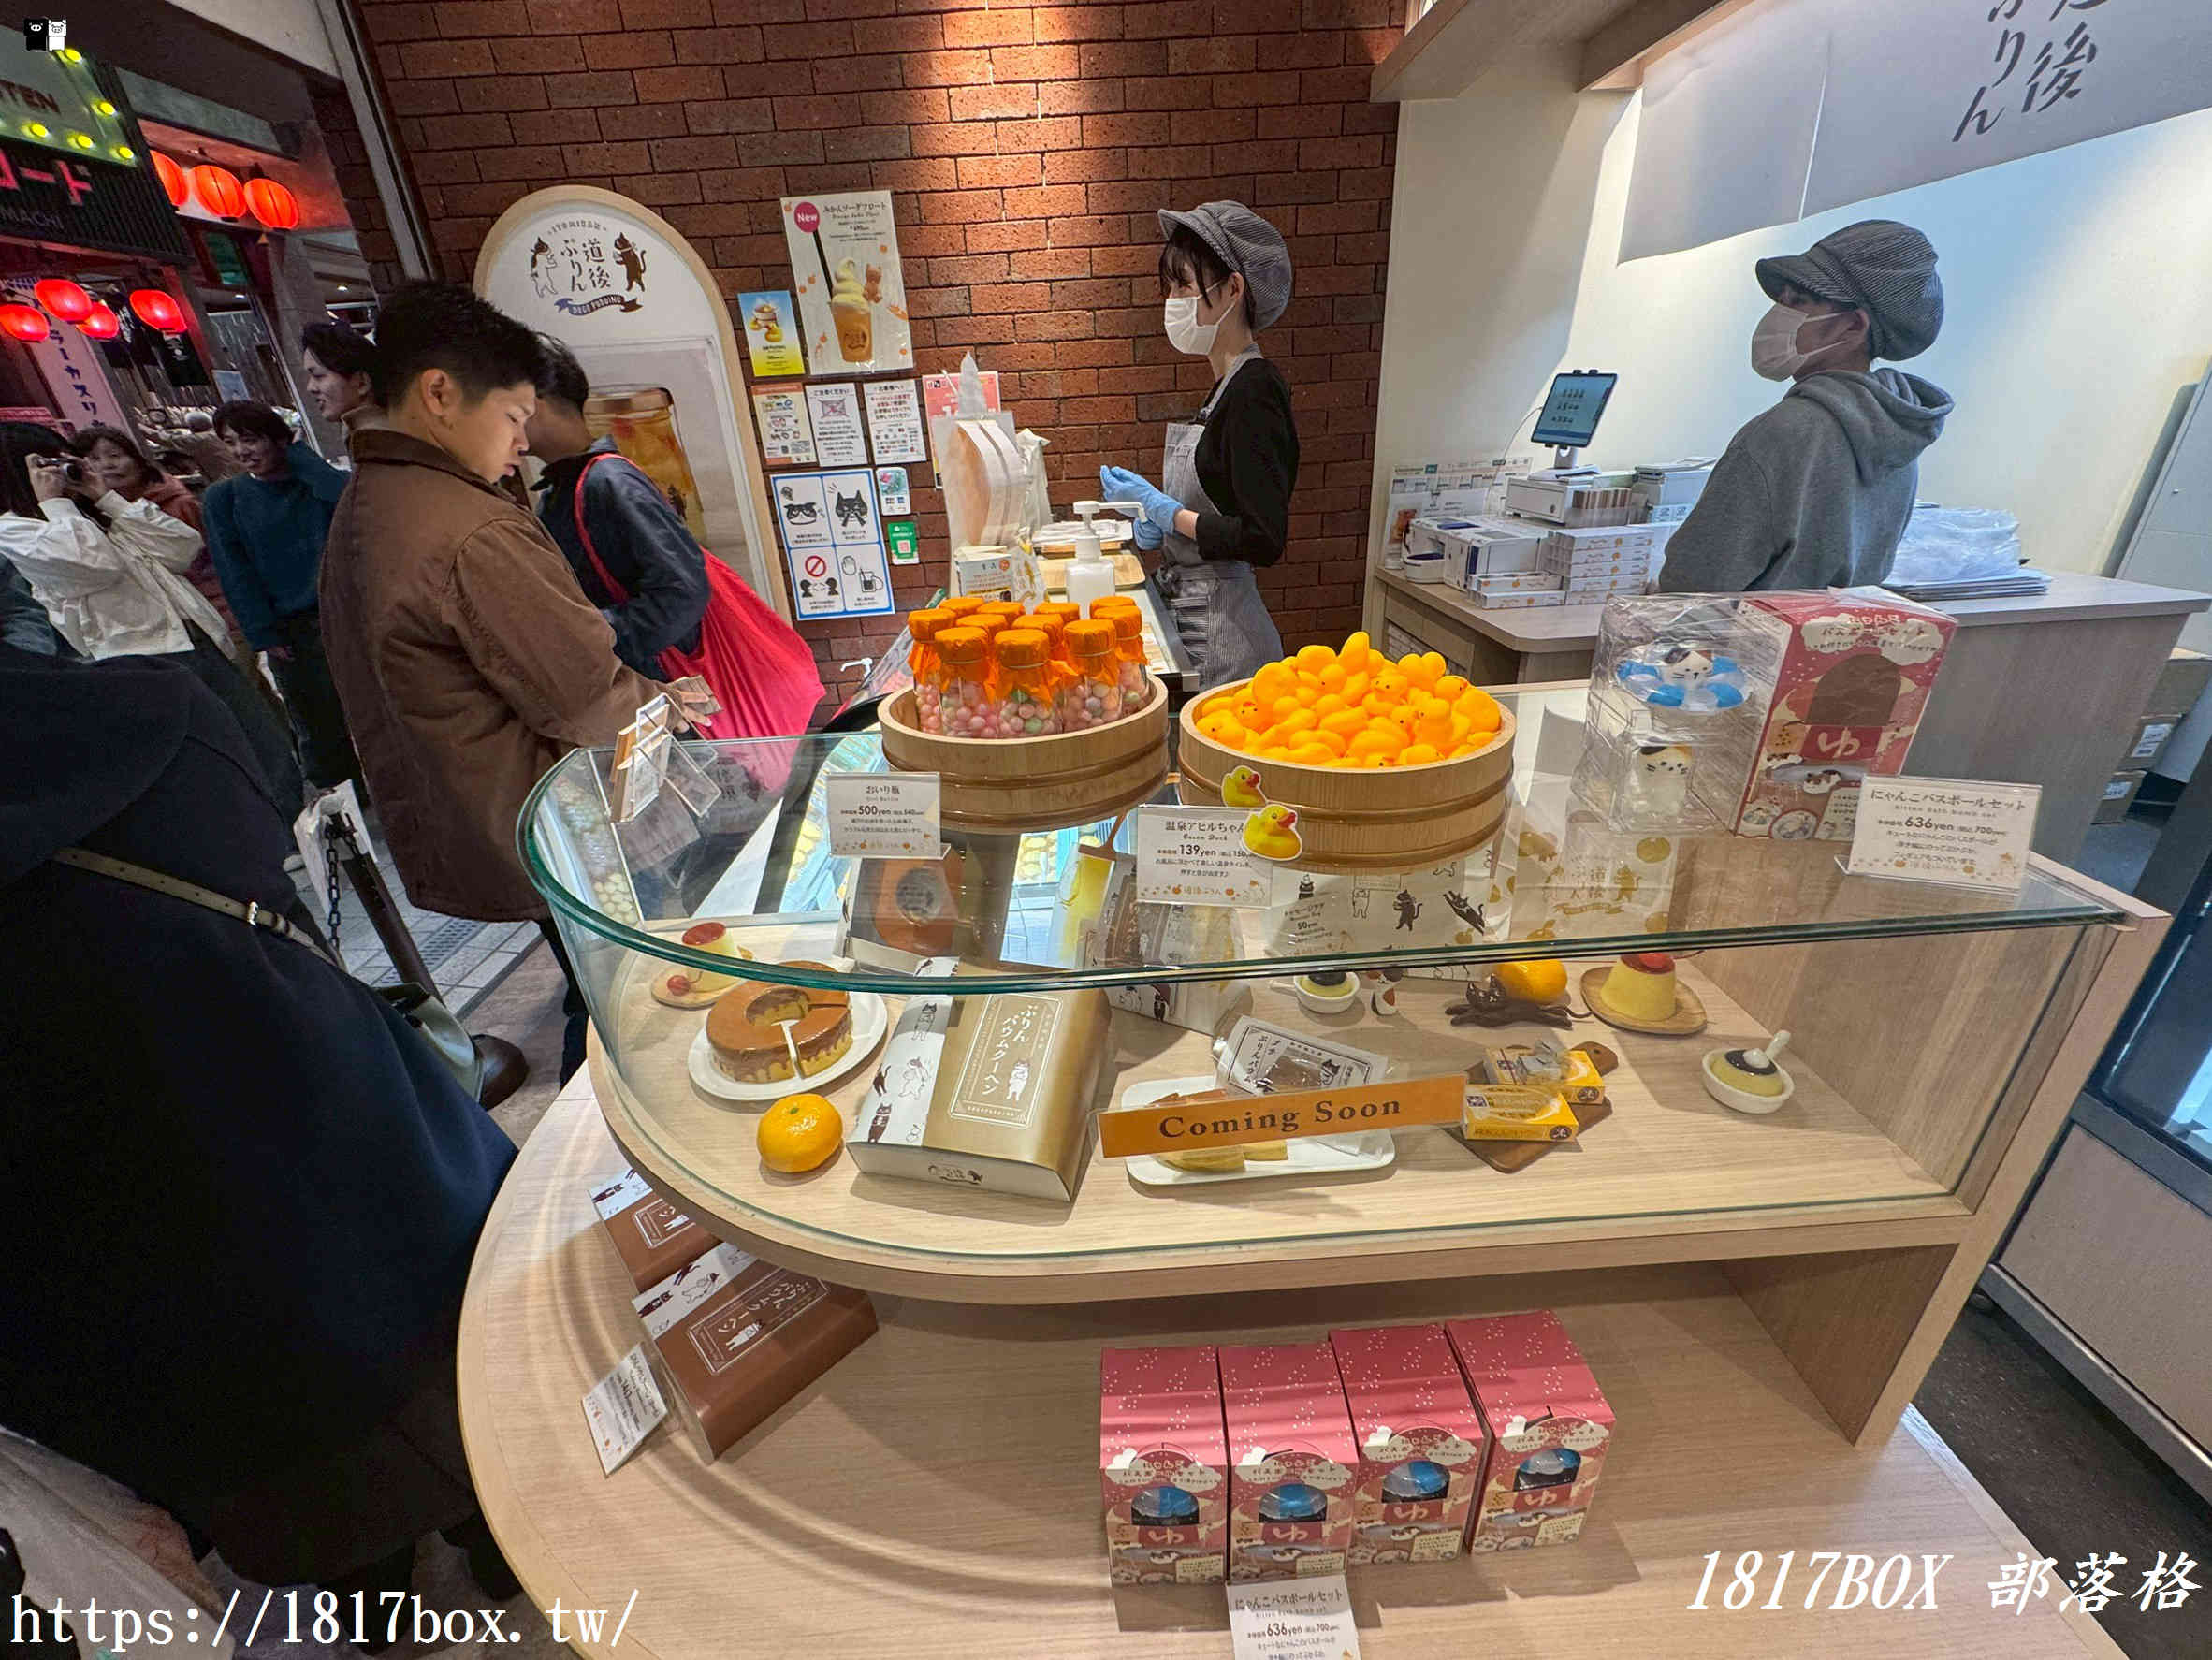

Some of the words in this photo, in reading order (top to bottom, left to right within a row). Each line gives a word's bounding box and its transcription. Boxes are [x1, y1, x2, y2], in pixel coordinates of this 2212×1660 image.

[796, 211, 818, 223] New
[560, 238, 587, 292] ぷりん
[583, 238, 611, 288] 道後
[1818, 727, 1860, 758] ゆ
[982, 1014, 1020, 1095] バウムクーヘン
[1158, 1112, 1301, 1139] Coming
[1314, 1098, 1401, 1123] Soon
[1524, 1491, 1557, 1506] ゆ
[1393, 1505, 1430, 1521] ゆ
[1148, 1525, 1185, 1544] ゆ
[1272, 1525, 1308, 1543] ゆ
